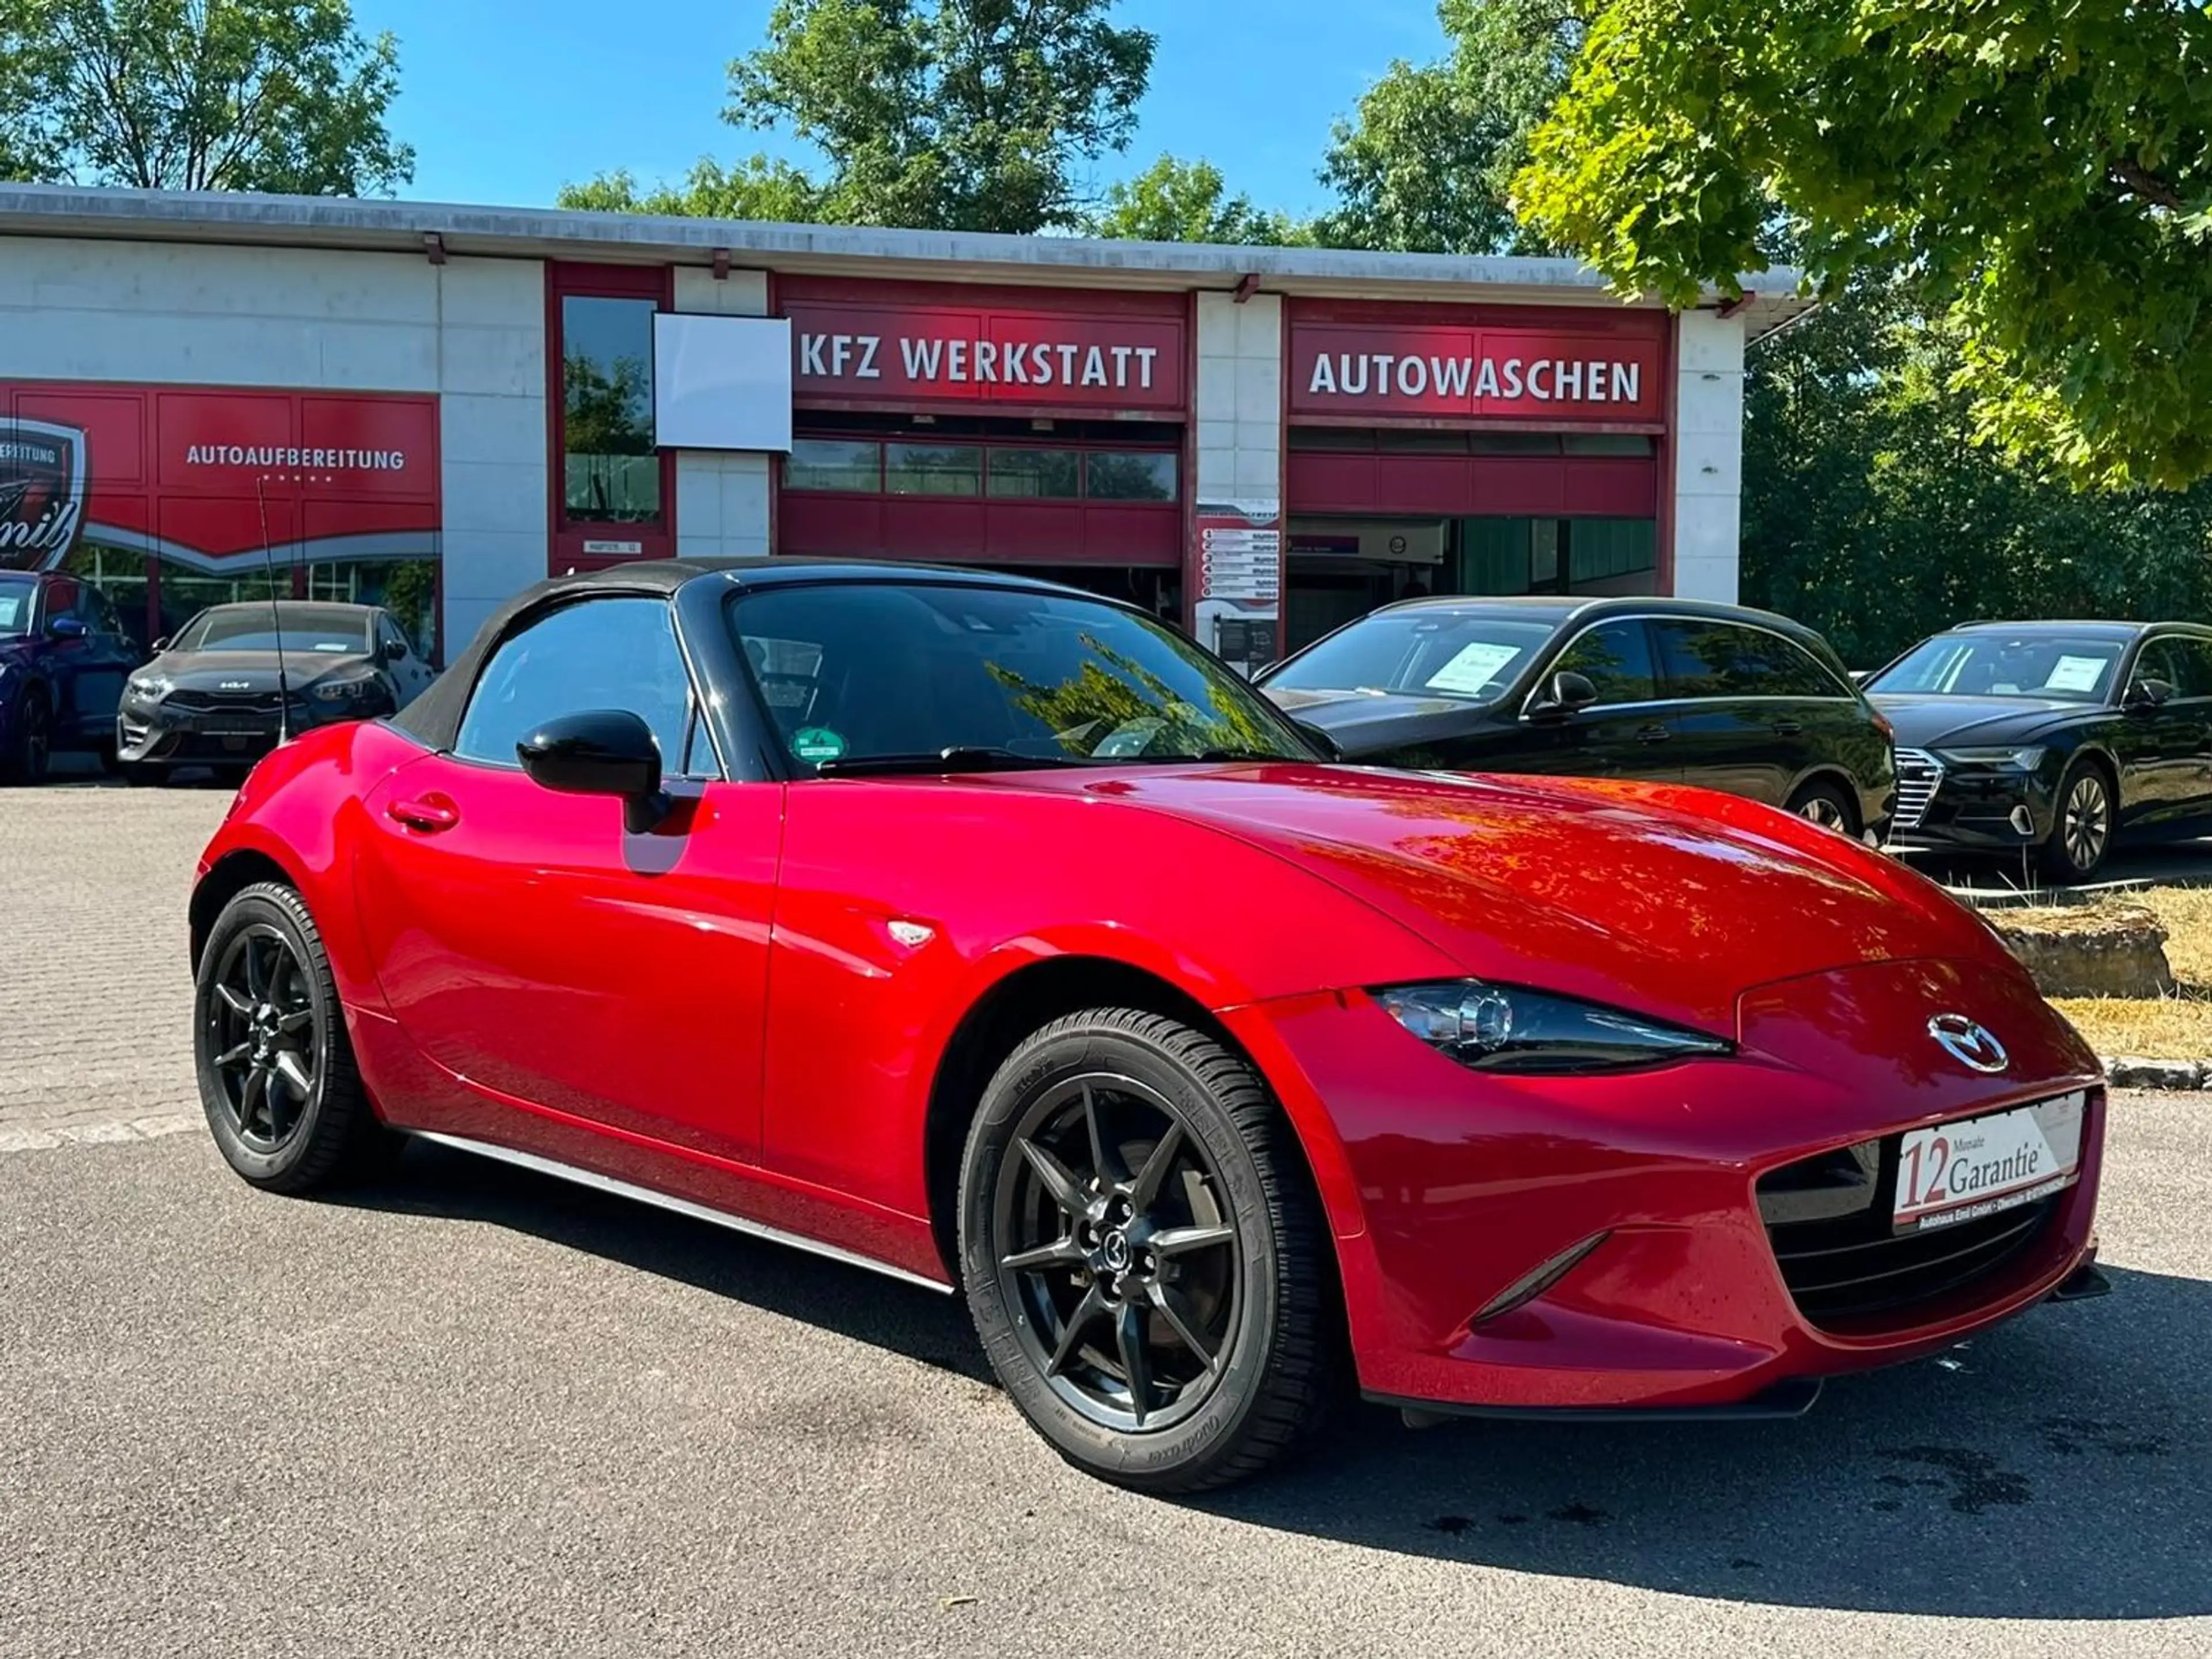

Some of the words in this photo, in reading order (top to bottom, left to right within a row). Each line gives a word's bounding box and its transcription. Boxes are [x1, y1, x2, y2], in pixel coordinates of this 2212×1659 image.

[801, 333, 881, 378] KFZ
[900, 337, 1157, 389] WERKSTATT
[1309, 353, 1640, 402] AUTOWASCHEN
[187, 445, 405, 470] AUTOAUFBEREITUNG
[1901, 1137, 1950, 1208] 12
